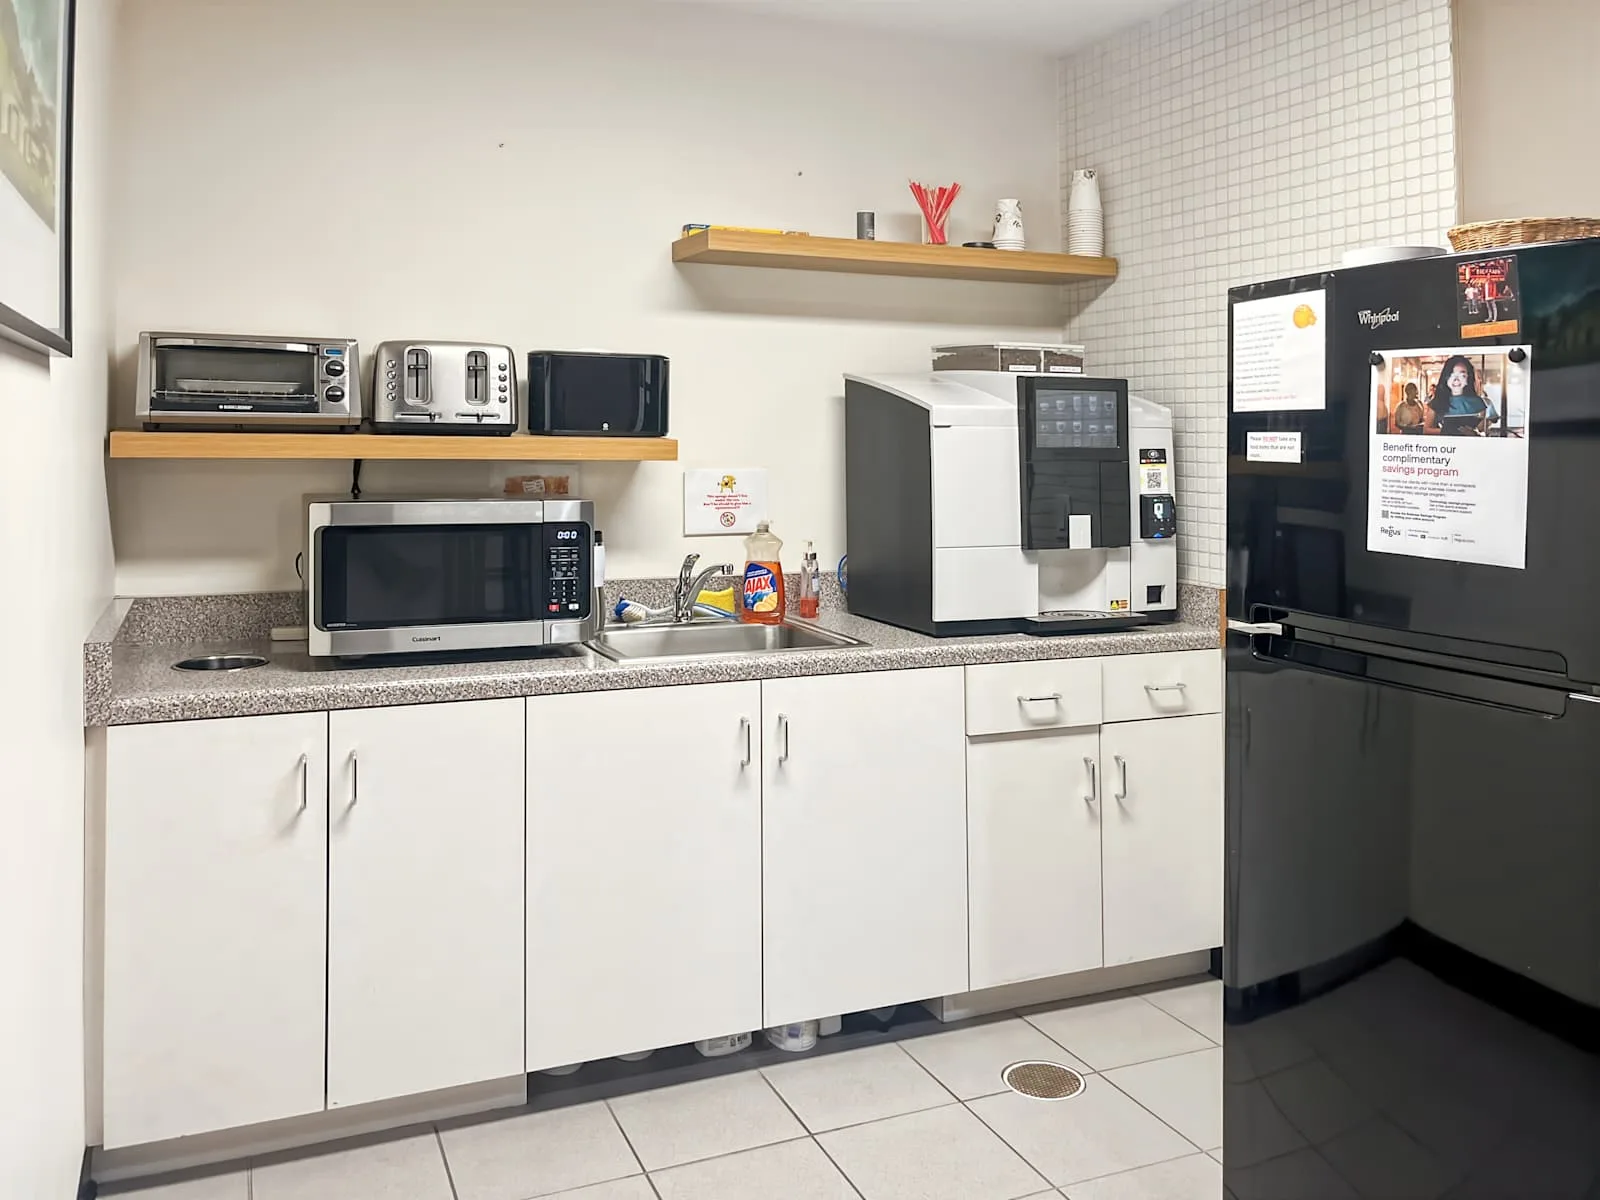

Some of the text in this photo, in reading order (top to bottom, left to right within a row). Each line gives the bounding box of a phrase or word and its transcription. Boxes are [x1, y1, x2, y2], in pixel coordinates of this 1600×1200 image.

[1357, 308, 1400, 329] Whirlpool
[1383, 443, 1413, 452] Benefit
[1415, 444, 1438, 453] from
[1382, 454, 1451, 466] complimentary
[1382, 465, 1459, 478] savings program
[556, 530, 577, 540] 0:00
[1380, 526, 1401, 537] Regus
[745, 576, 771, 594] AJAX
